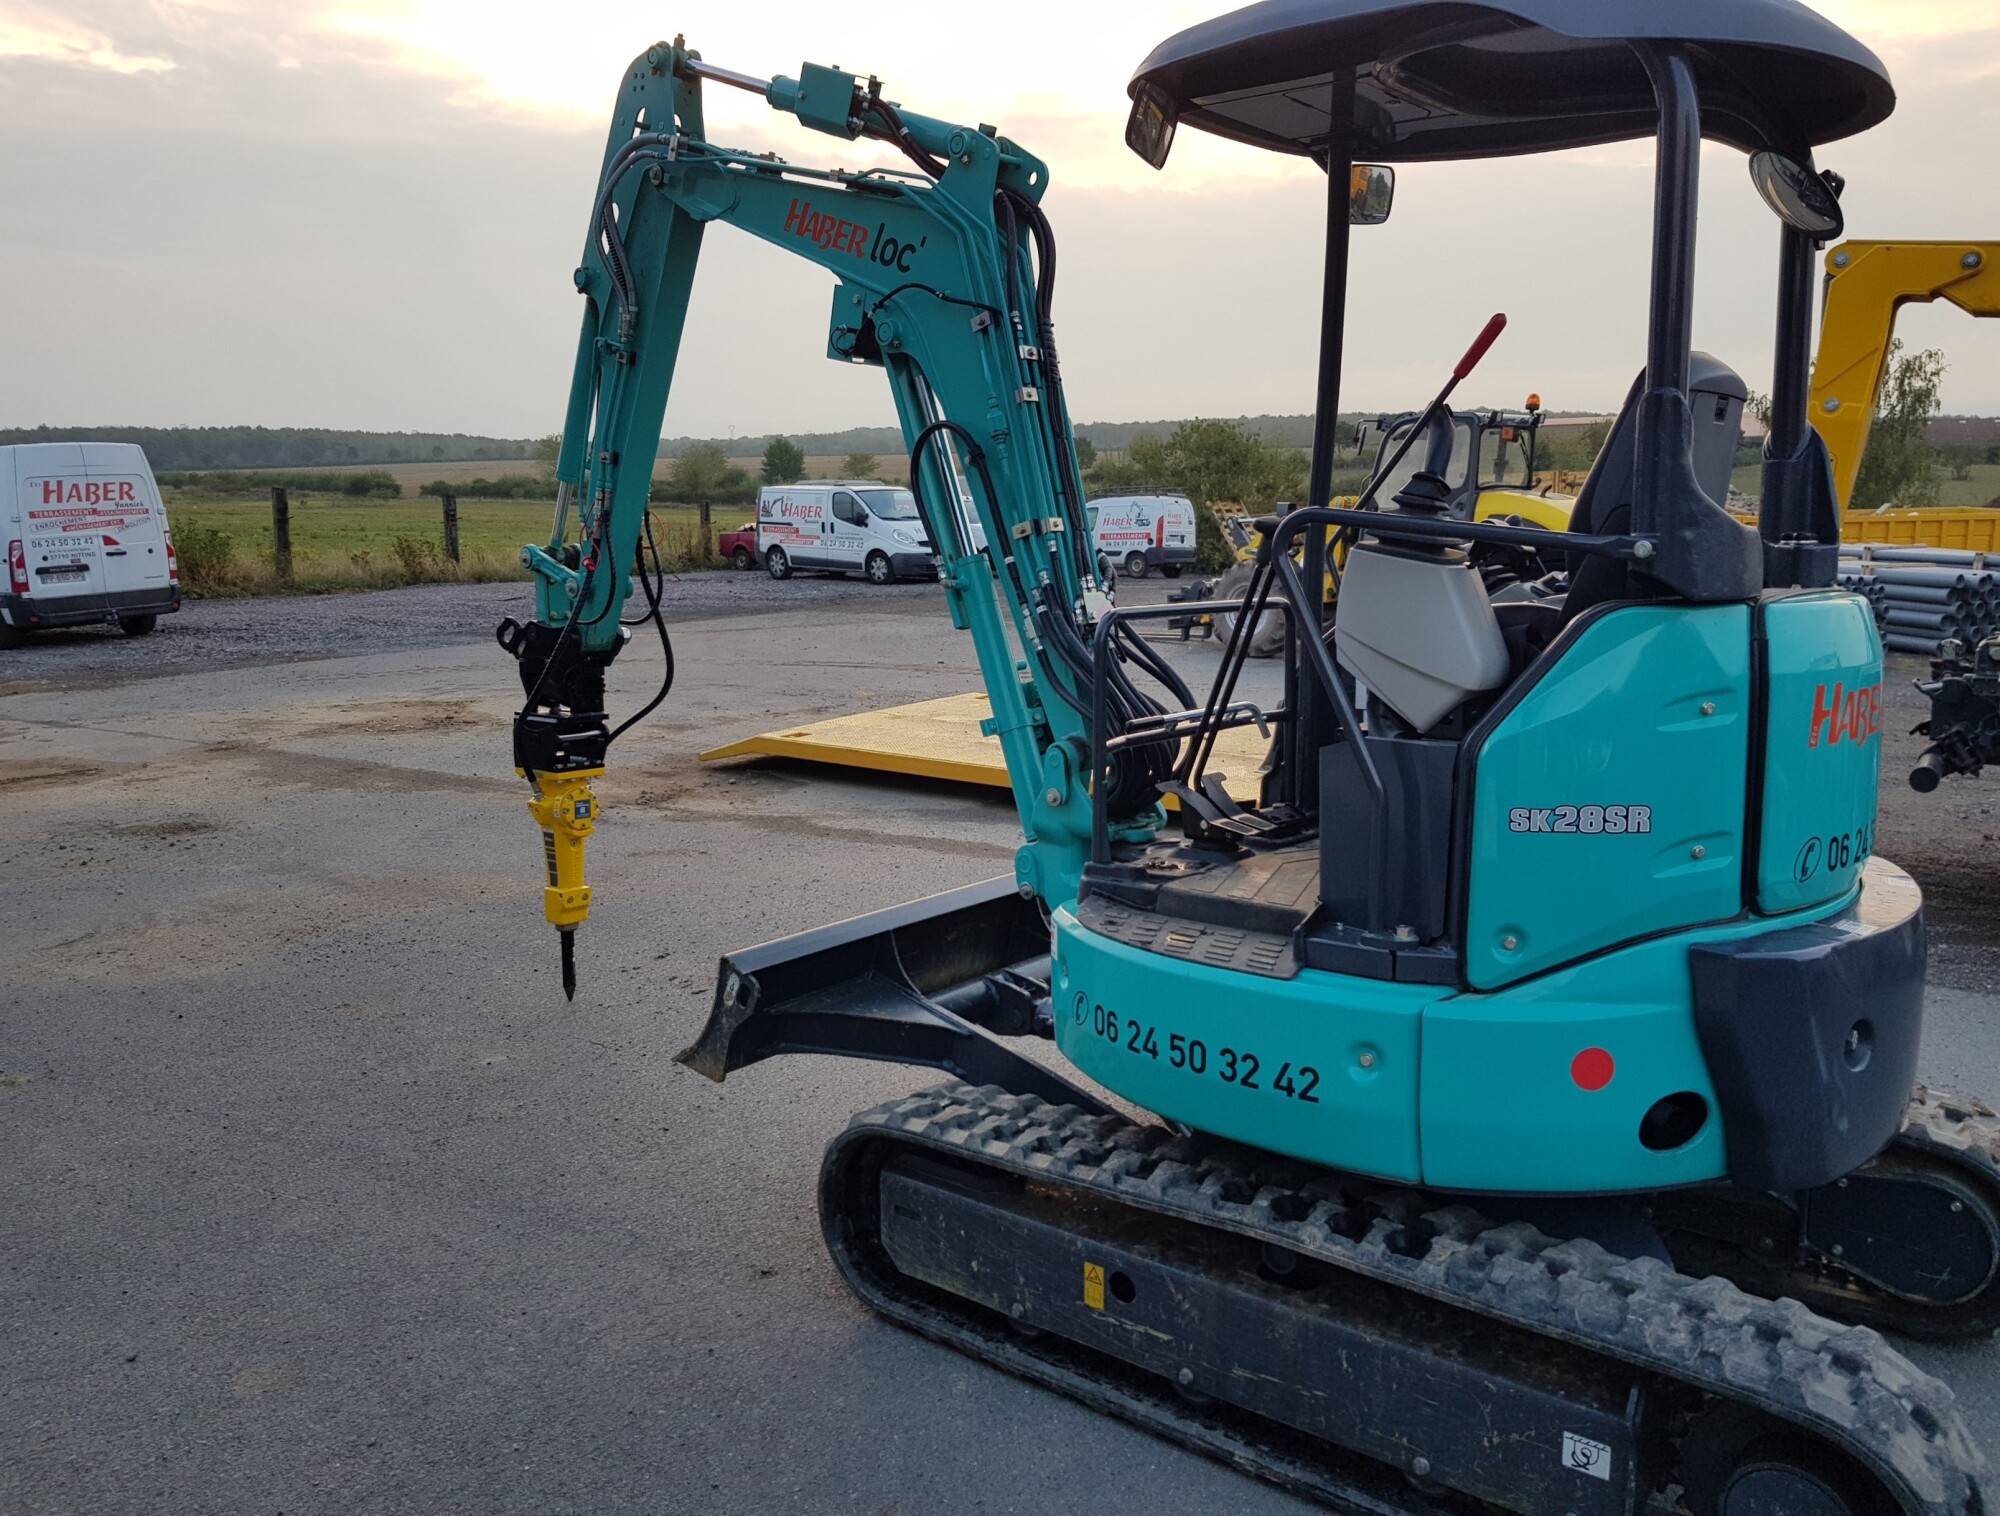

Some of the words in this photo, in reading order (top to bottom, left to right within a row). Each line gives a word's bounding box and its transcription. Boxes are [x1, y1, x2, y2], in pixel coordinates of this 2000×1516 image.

[783, 198, 869, 259] HABER
[43, 480, 135, 505] HABER
[34, 508, 93, 517] TERRASSEMENT
[783, 502, 823, 519] HABER
[1103, 517, 1132, 527] HABER
[35, 516, 88, 531] ENROCHEMENT
[31, 540, 43, 548] 06
[71, 538, 81, 546] 32
[84, 537, 94, 545] 42
[1808, 682, 1882, 748] HABE
[1509, 805, 1651, 834] SK28SR
[1828, 833, 1850, 872] 06
[1854, 823, 1869, 863] 24
[1094, 1004, 1119, 1043] 06
[1127, 1020, 1159, 1060] 24
[1169, 1033, 1207, 1074] 50
[1219, 1048, 1260, 1090] 32
[1273, 1061, 1320, 1103] 42
